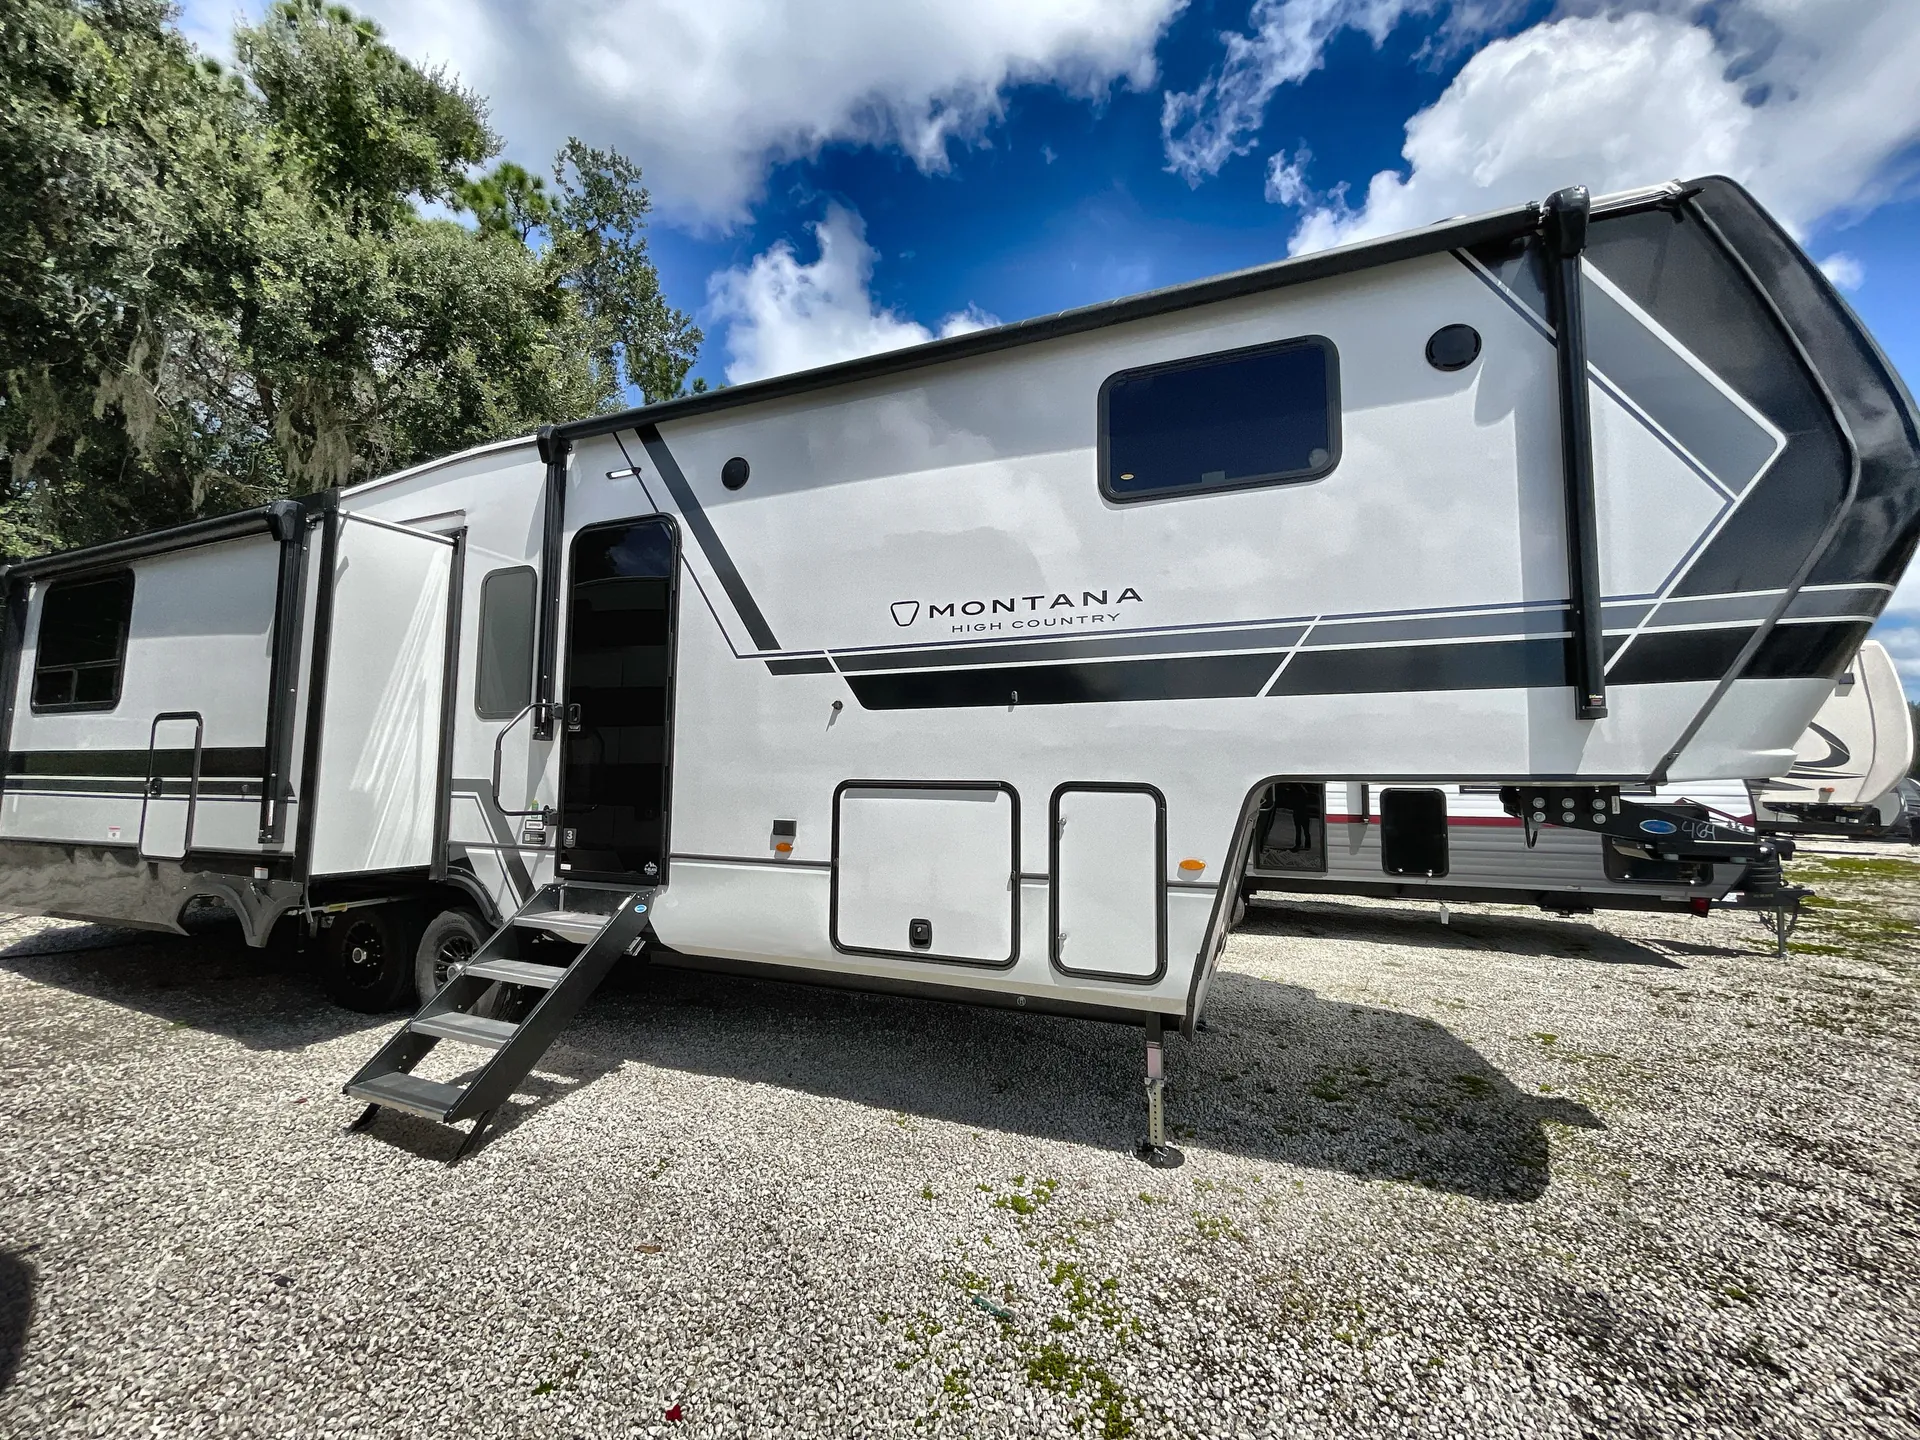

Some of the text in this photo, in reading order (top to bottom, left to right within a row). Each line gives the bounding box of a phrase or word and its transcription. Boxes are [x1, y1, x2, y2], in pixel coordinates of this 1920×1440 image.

[929, 587, 1143, 619] MONTANA
[952, 612, 1121, 633] HIGH COUNTRY
[566, 830, 573, 840] 3
[1681, 820, 1716, 840] 464
